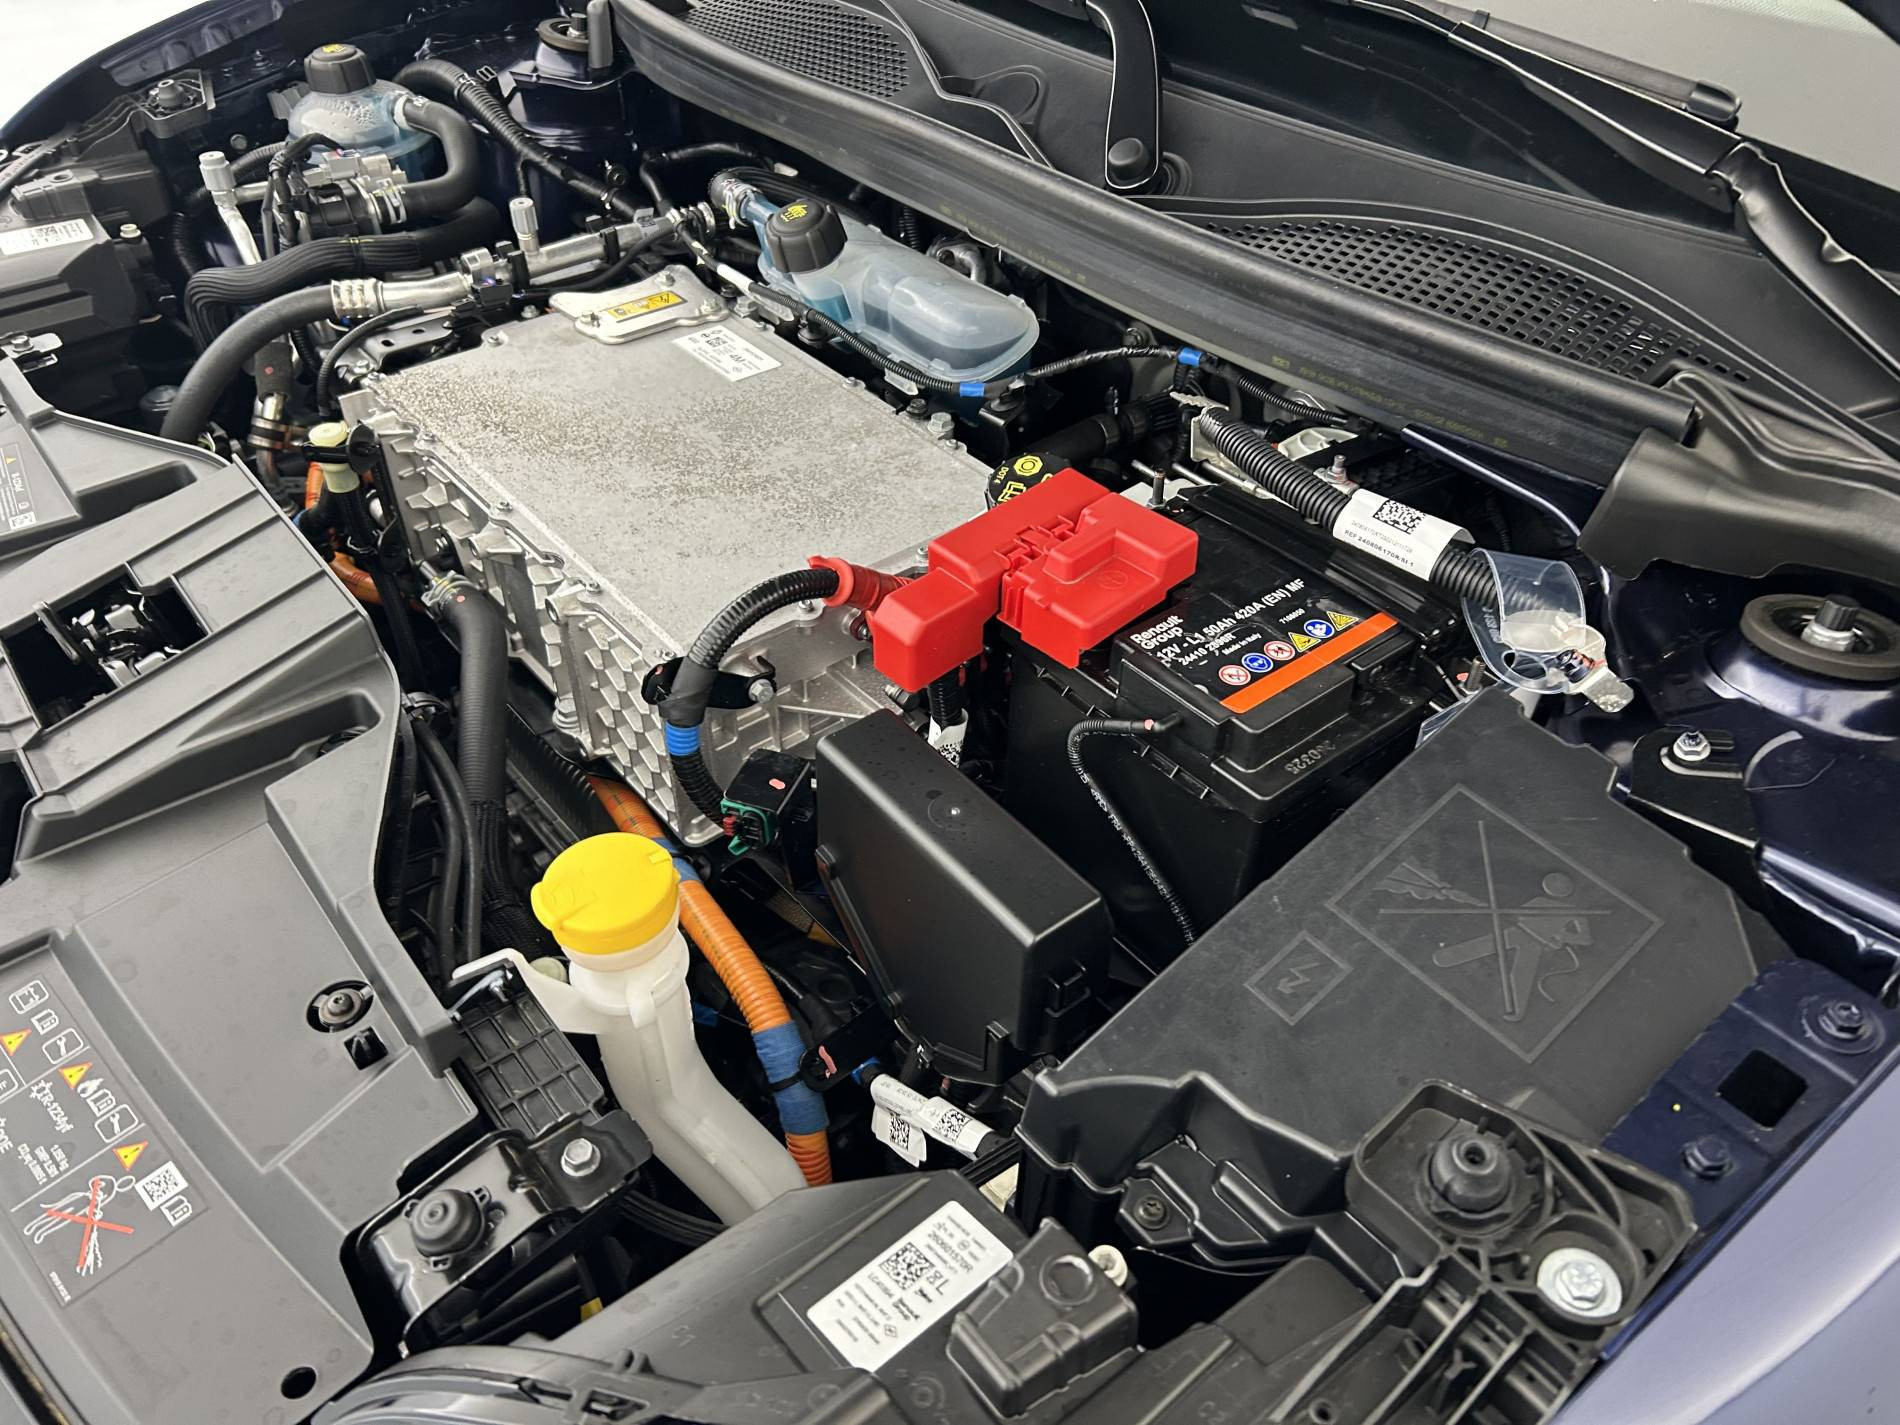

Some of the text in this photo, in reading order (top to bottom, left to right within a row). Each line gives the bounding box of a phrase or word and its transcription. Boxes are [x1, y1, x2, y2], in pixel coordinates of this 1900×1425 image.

[1130, 615, 1184, 645] Renault
[1156, 641, 1182, 660] 12V
[1204, 616, 1238, 637] 50Ah
[1233, 601, 1266, 621] 420A
[1261, 587, 1292, 608] (EN)
[1289, 578, 1306, 593] MF
[1141, 627, 1184, 651] Group
[41, 1091, 74, 1133] R-1234yf
